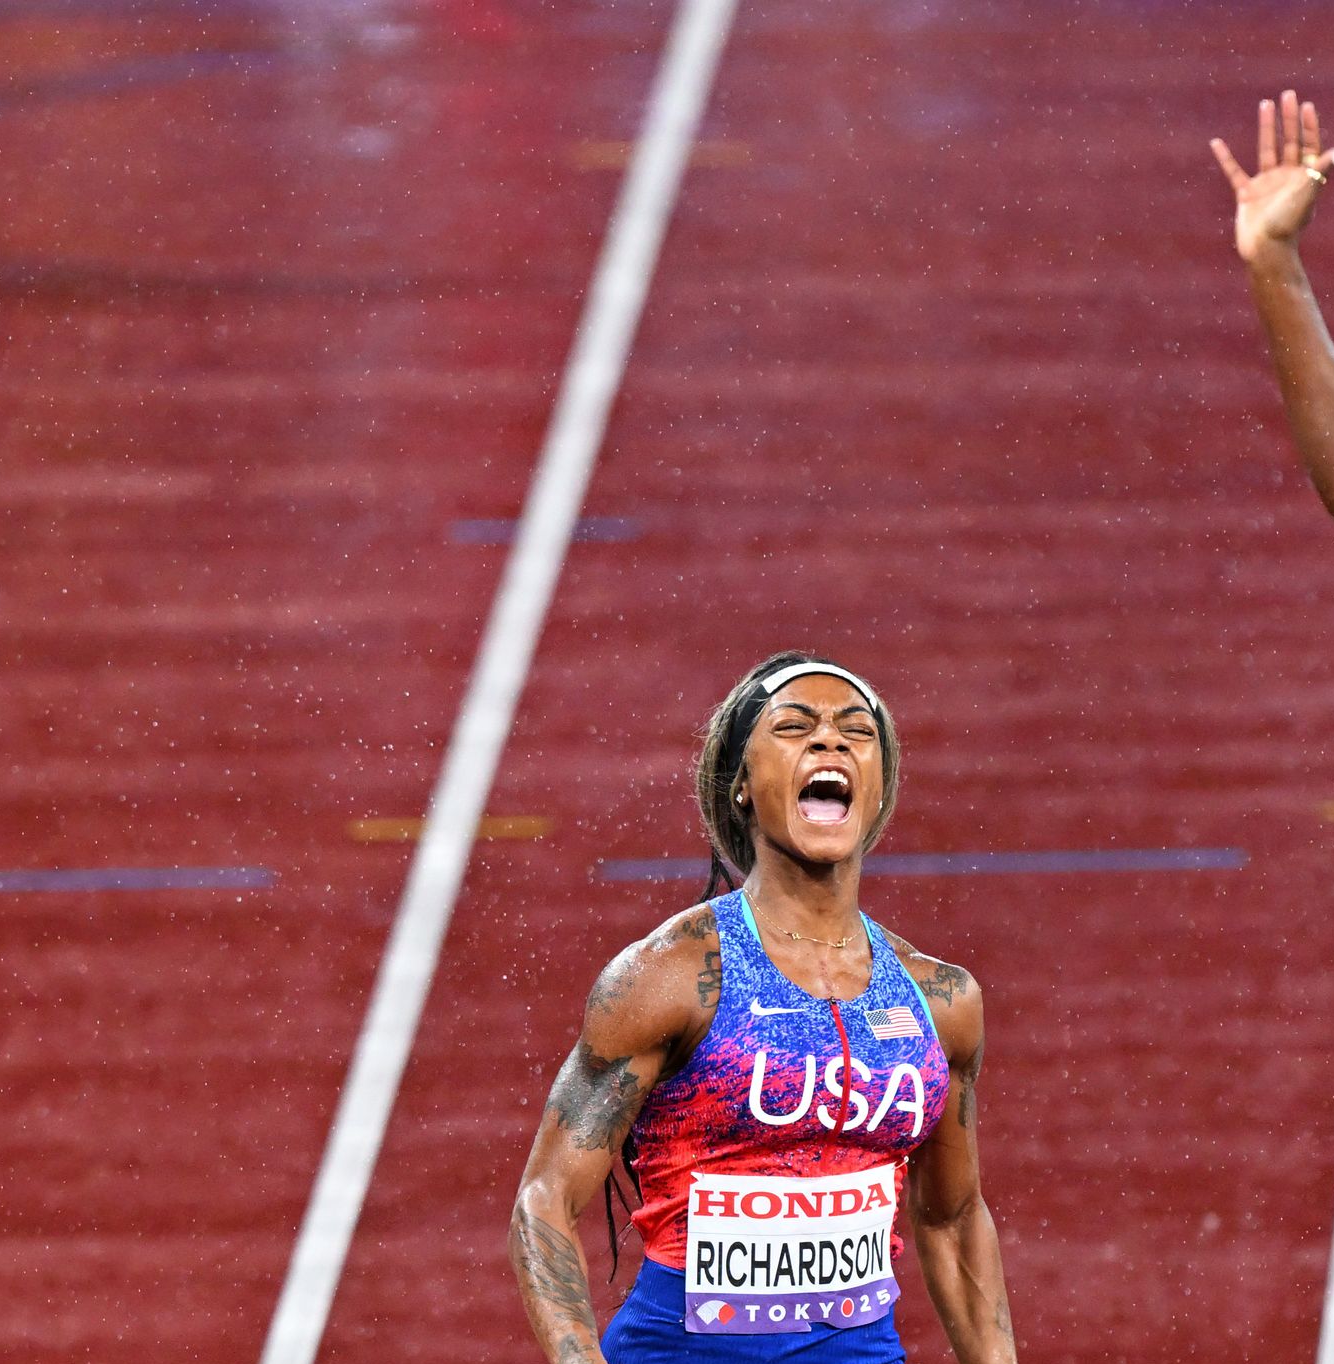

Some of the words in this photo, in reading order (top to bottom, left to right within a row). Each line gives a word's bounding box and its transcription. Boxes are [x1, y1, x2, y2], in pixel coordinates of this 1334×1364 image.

[749, 1052, 925, 1138] USA
[693, 1183, 892, 1219] HONDA
[696, 1229, 886, 1287] RICHARDSON
